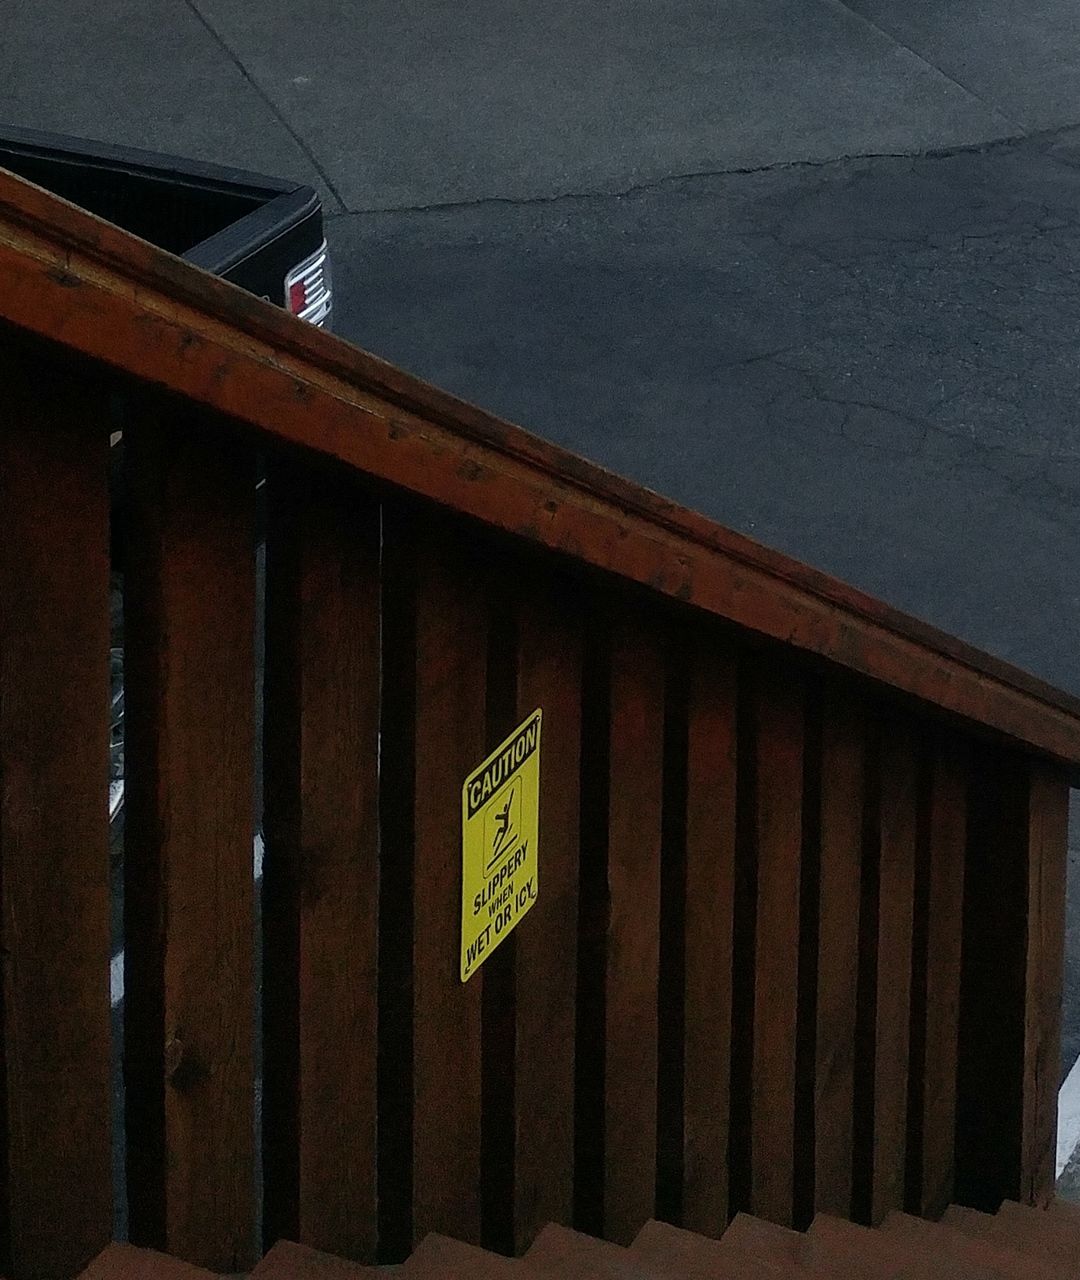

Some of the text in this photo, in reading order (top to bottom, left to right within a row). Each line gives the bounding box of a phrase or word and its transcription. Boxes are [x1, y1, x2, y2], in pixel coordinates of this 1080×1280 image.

[470, 722, 536, 810] CAUTION
[473, 839, 528, 916] SLIPPERY
[488, 880, 514, 918] WHEN
[466, 876, 533, 968] WET OR ICY
